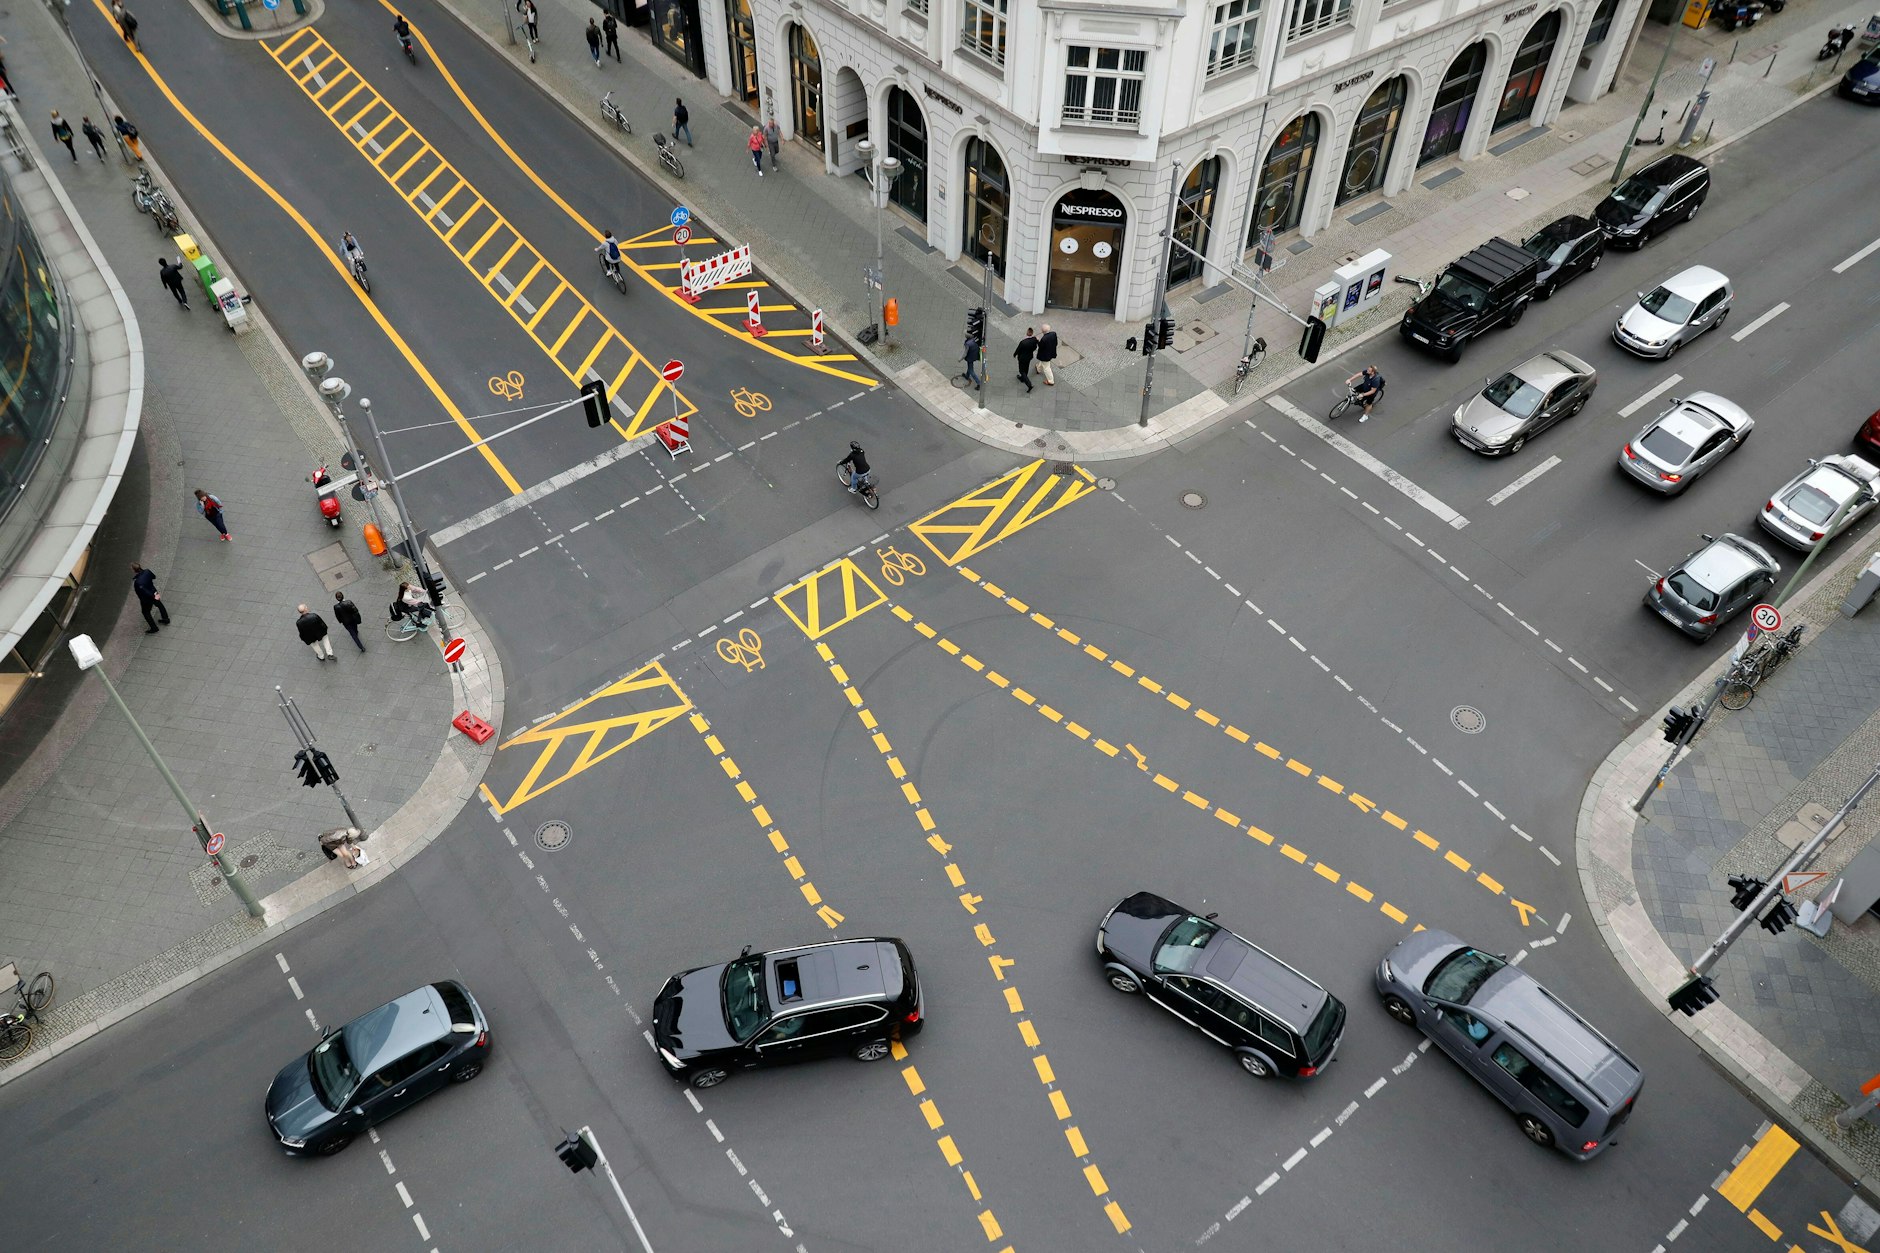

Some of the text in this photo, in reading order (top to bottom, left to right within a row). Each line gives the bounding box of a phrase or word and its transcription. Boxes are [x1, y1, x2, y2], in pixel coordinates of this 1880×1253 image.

[1333, 70, 1374, 94] NESPRESSO
[1060, 203, 1122, 217] NESPRESSO
[677, 230, 687, 241] 20
[1757, 609, 1776, 626] 30
